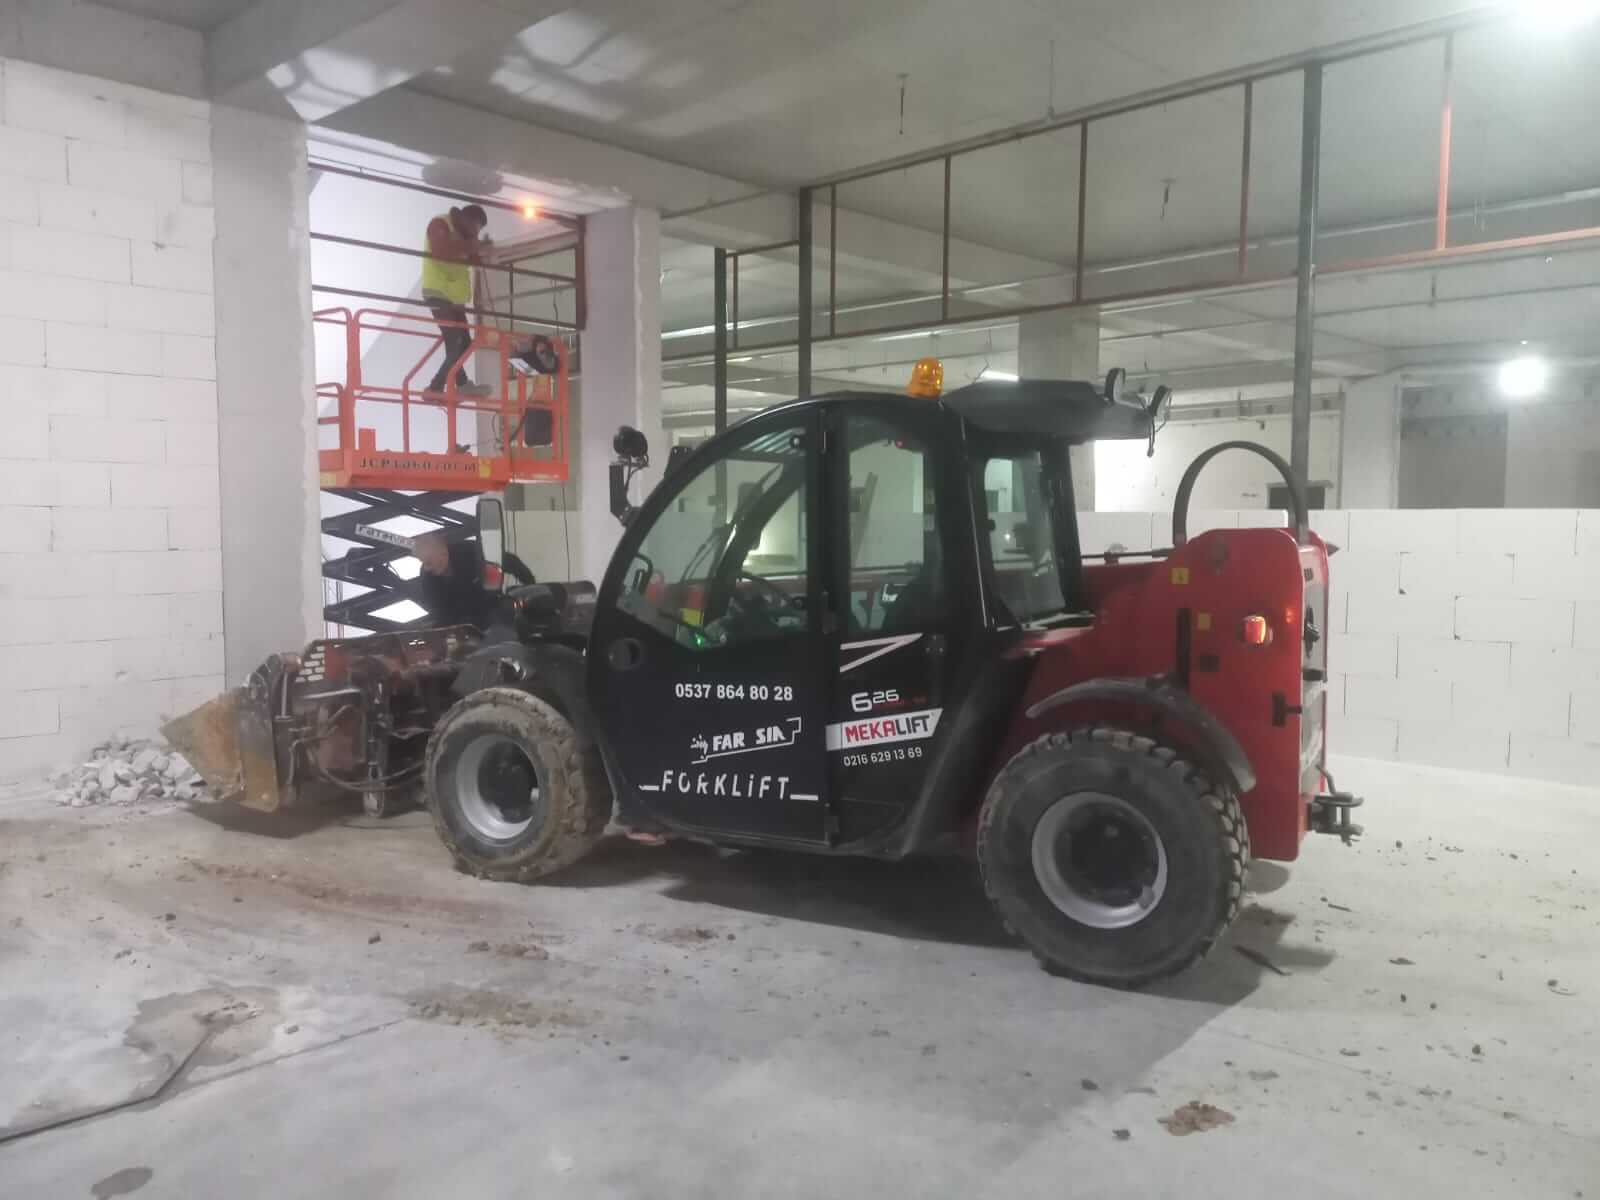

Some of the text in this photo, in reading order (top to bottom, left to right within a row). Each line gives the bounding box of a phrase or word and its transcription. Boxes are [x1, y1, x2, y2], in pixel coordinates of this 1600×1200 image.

[675, 683, 793, 702] 0537 864 80 28
[845, 714, 930, 742] MEKALIFT
[712, 732, 745, 752] FAR
[843, 754, 867, 768] 0216
[871, 751, 891, 763] 629
[893, 749, 905, 761] 13
